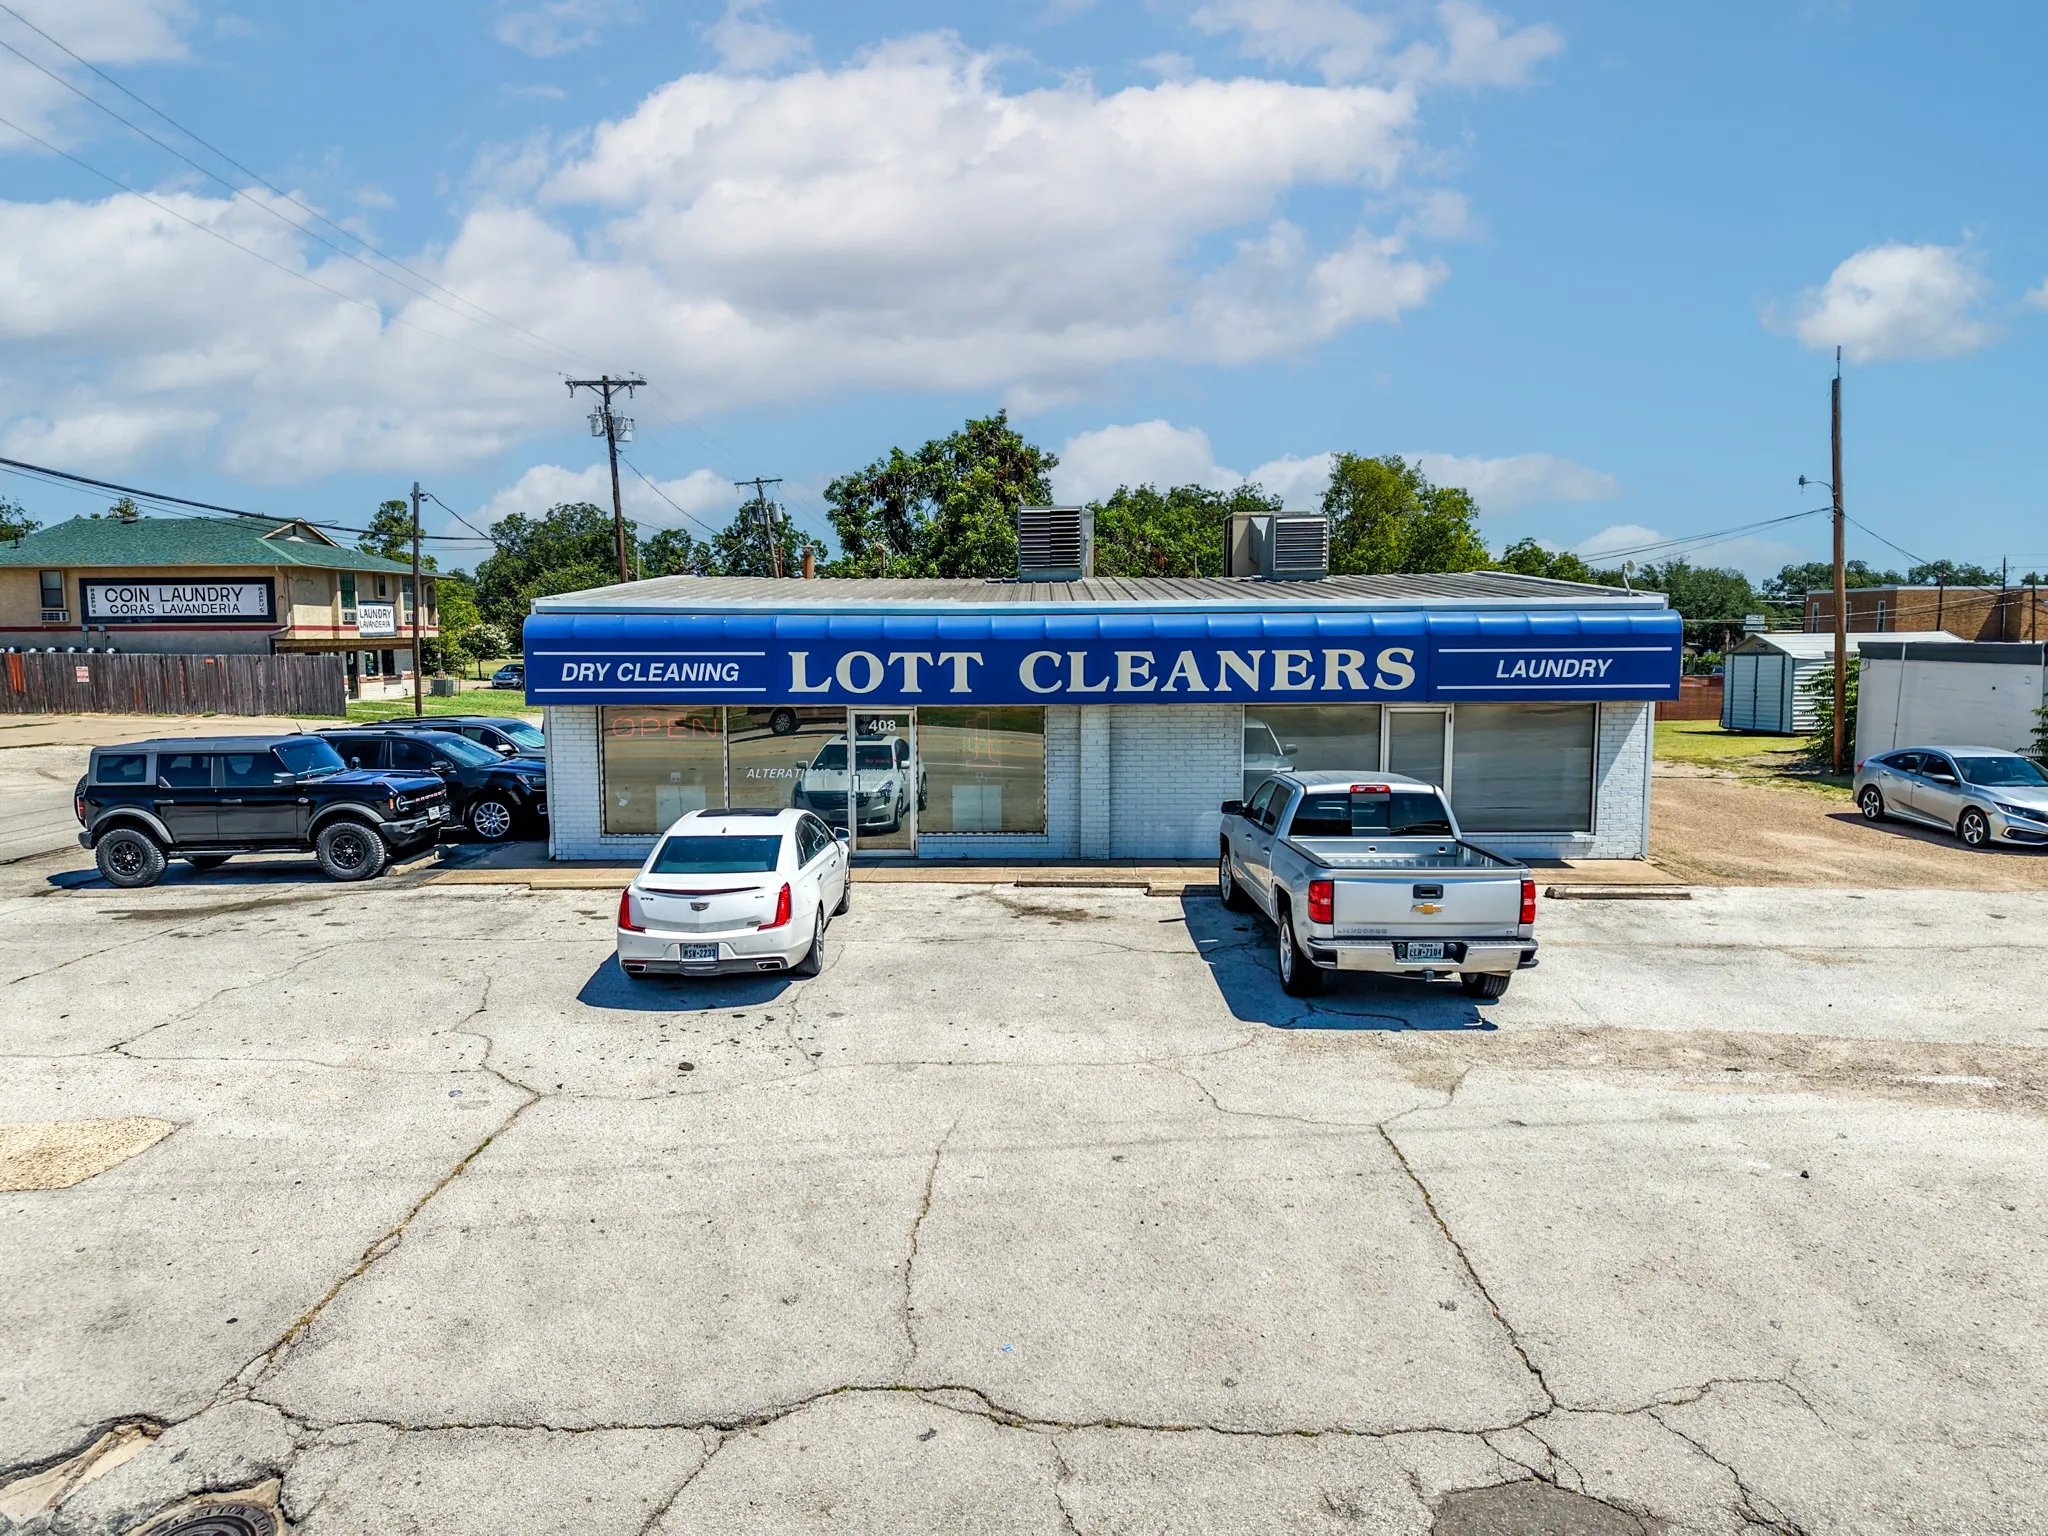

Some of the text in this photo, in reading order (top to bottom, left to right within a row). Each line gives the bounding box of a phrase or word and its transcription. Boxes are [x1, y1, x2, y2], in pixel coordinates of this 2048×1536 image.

[105, 587, 243, 603] COIN LAUNDRY
[110, 603, 241, 614] CORAS LAVANDERIA
[359, 608, 392, 619] LAUNDRY
[360, 620, 391, 628] LAVANDERIA
[561, 662, 740, 682] DRY CLEANING
[788, 647, 1416, 694] LOTT CLEANERS
[1496, 658, 1614, 679] LAUNDRY
[612, 718, 717, 738] OPEN
[868, 719, 897, 732] 408
